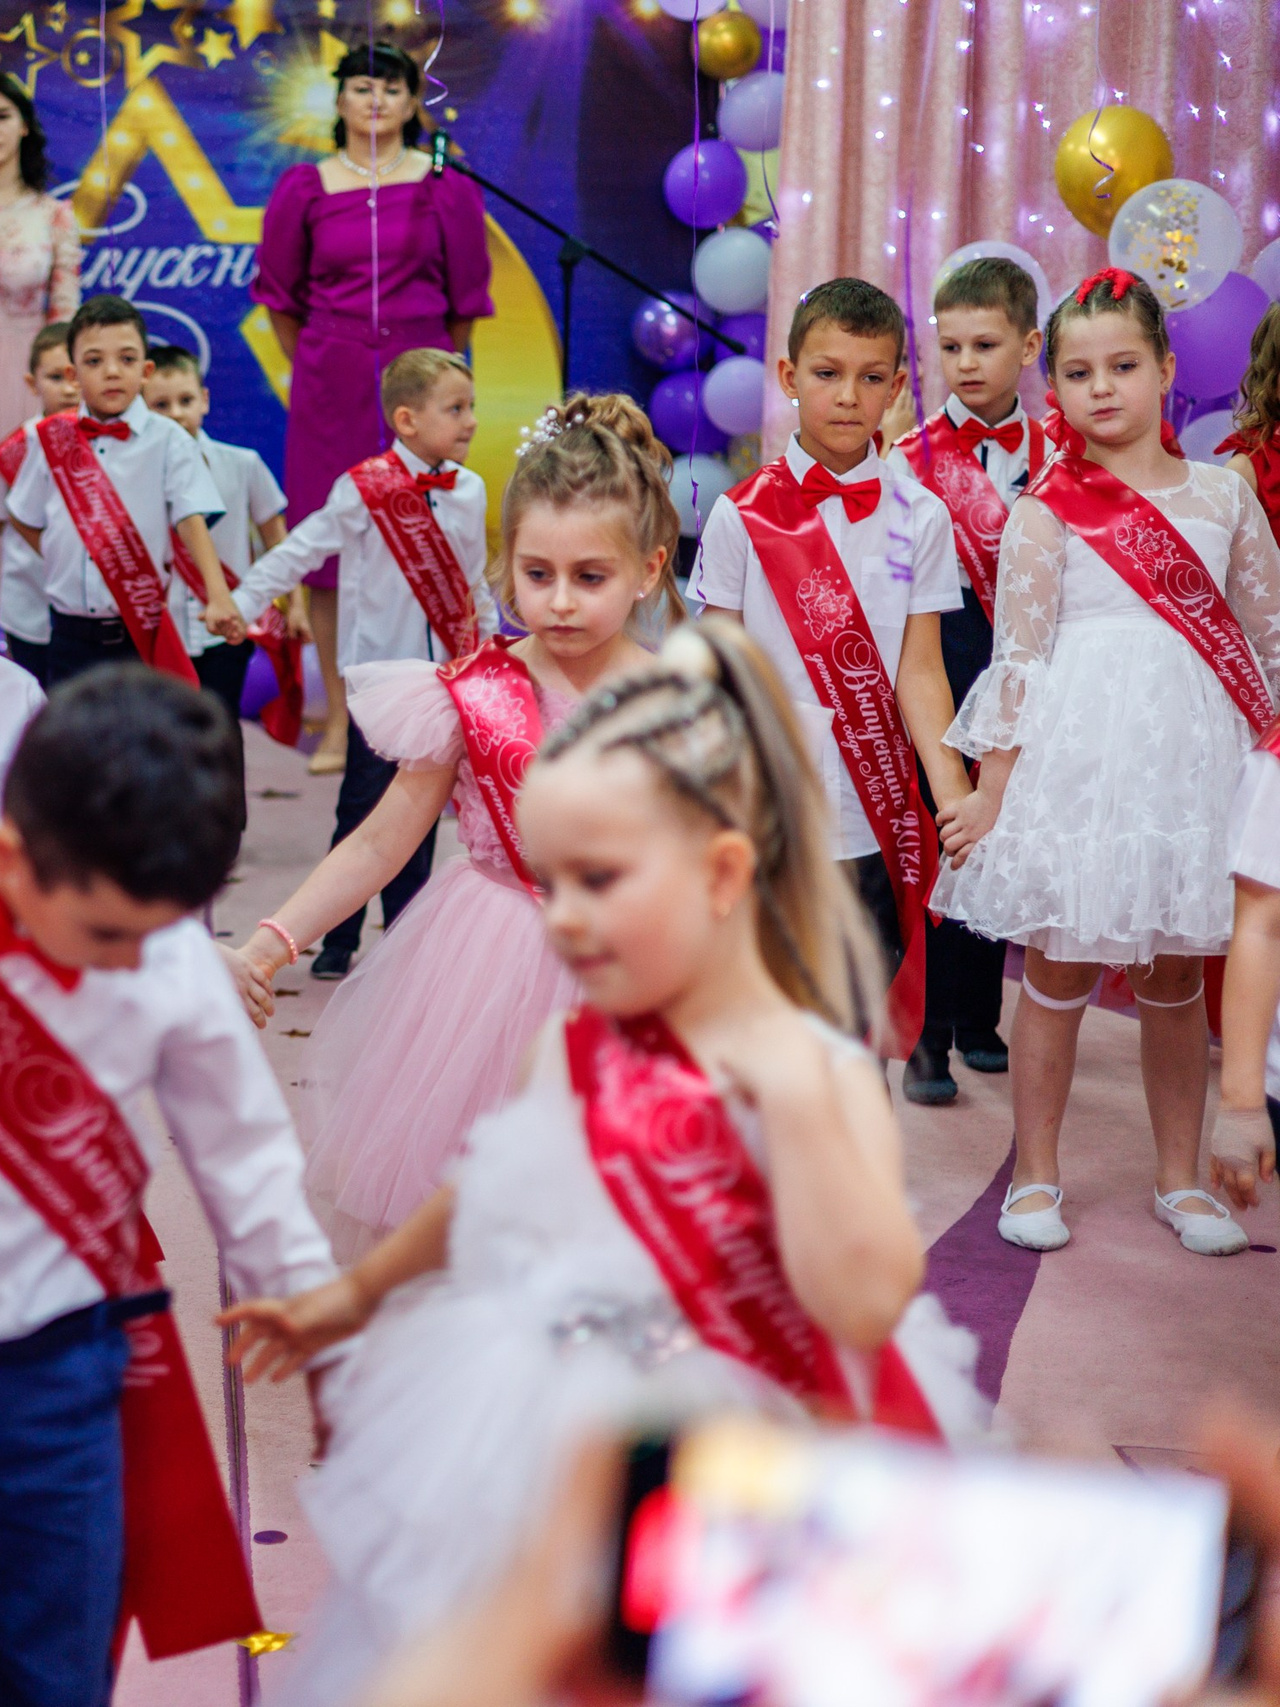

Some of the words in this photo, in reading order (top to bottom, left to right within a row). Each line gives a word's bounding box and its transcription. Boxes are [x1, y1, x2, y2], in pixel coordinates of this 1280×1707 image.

[122, 575, 161, 630] 2024
[1149, 593, 1212, 652] детского
[1213, 654, 1238, 687] сада
[804, 653, 848, 722] детского
[841, 722, 861, 760] сада
[859, 761, 882, 804] №4
[831, 630, 904, 810] Выпускник
